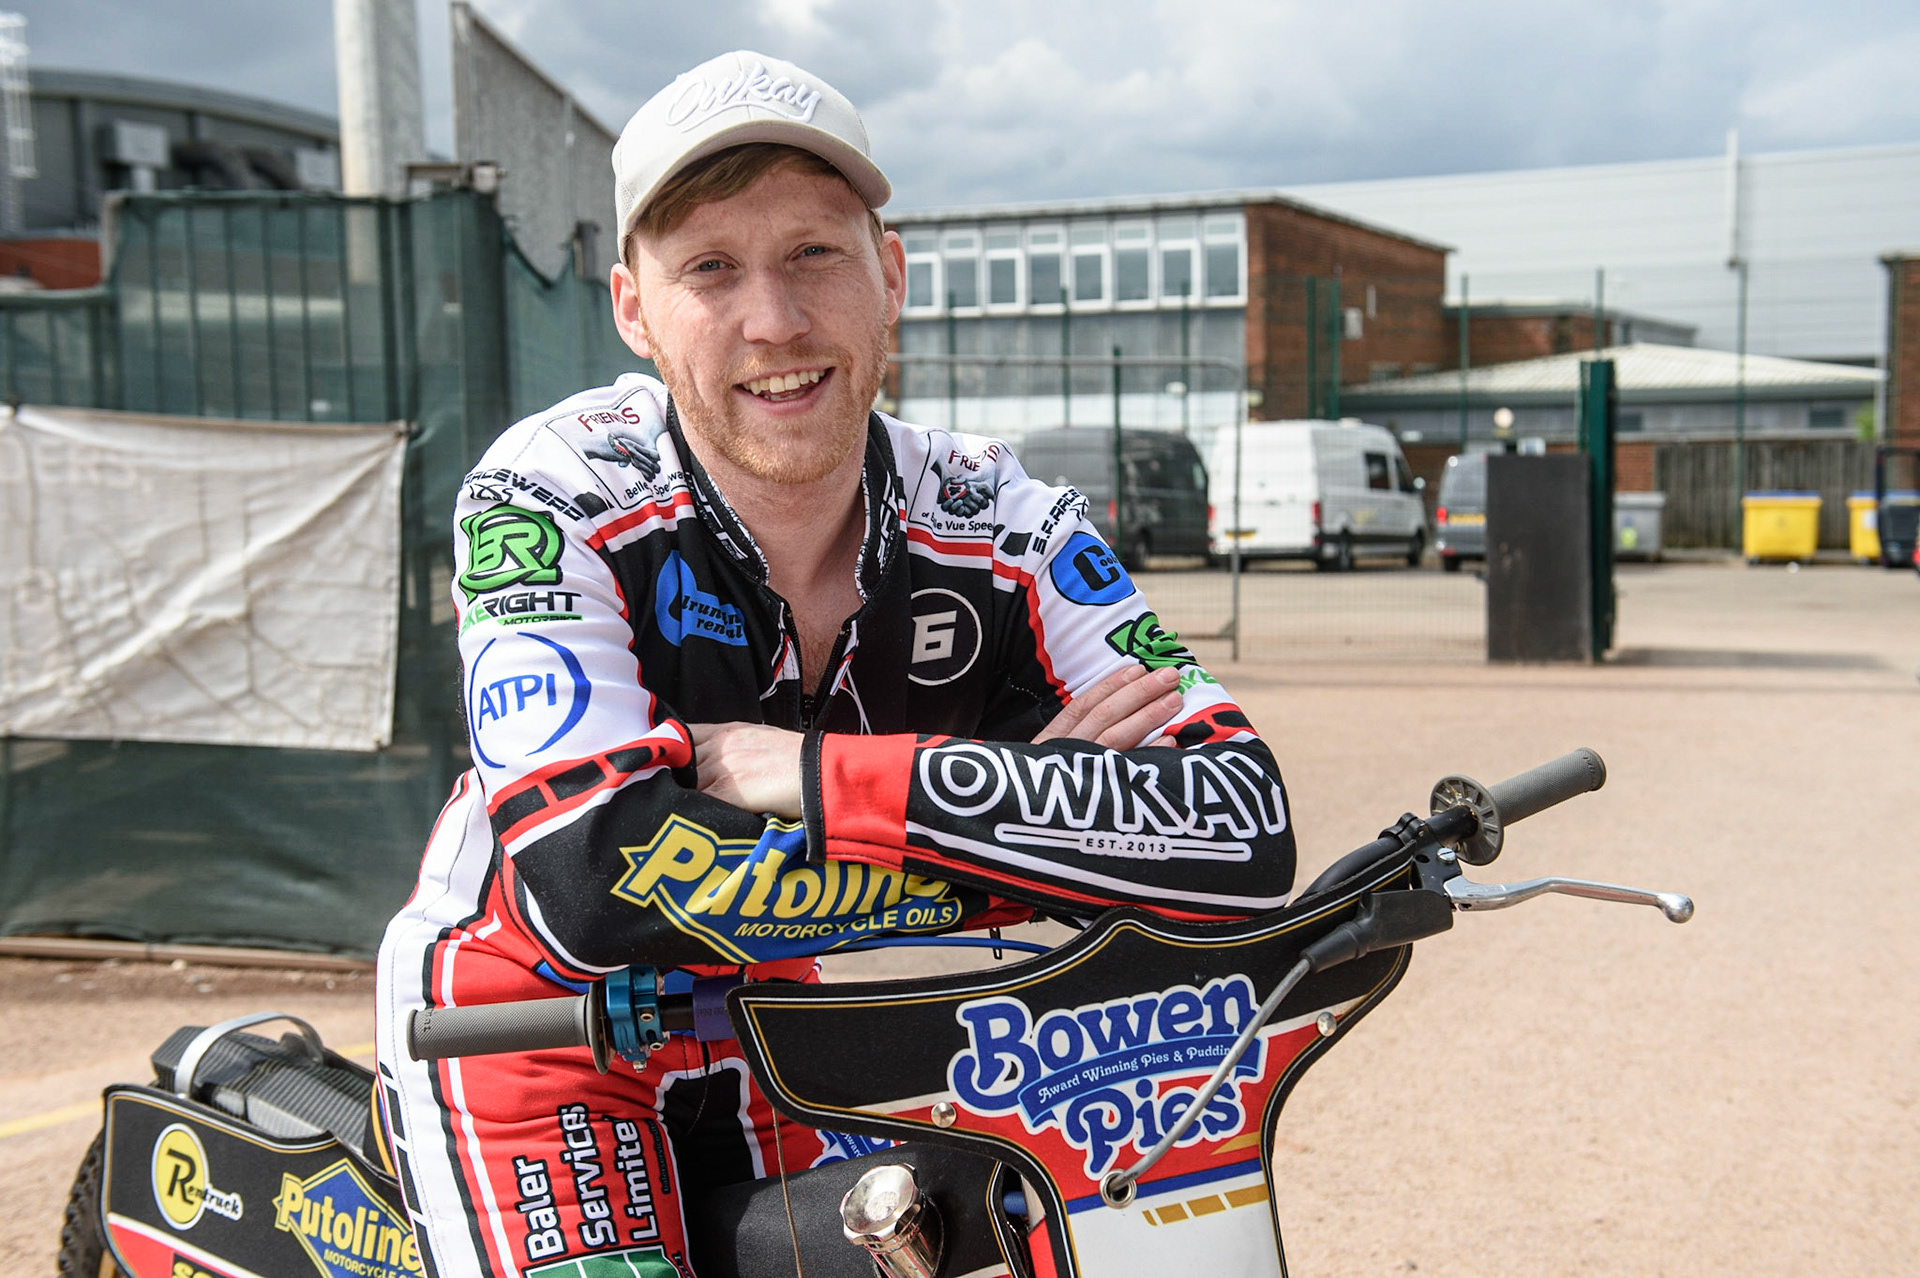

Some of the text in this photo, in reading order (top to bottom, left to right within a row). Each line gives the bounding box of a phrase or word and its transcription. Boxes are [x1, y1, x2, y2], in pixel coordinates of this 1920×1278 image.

[945, 520, 966, 532] Vue
[478, 672, 557, 731] ATPI
[919, 743, 1286, 840] OWKAY
[734, 906, 953, 939] MOTORCYCLE OILS
[953, 980, 1257, 1111] Bowen
[1037, 1046, 1232, 1104] Award Winning Pies & Puddin
[1066, 1079, 1241, 1174] Pies
[279, 1175, 422, 1273] Putoline
[514, 1157, 565, 1259] Baler
[560, 1105, 617, 1246] Services
[611, 1117, 659, 1240] Limite
